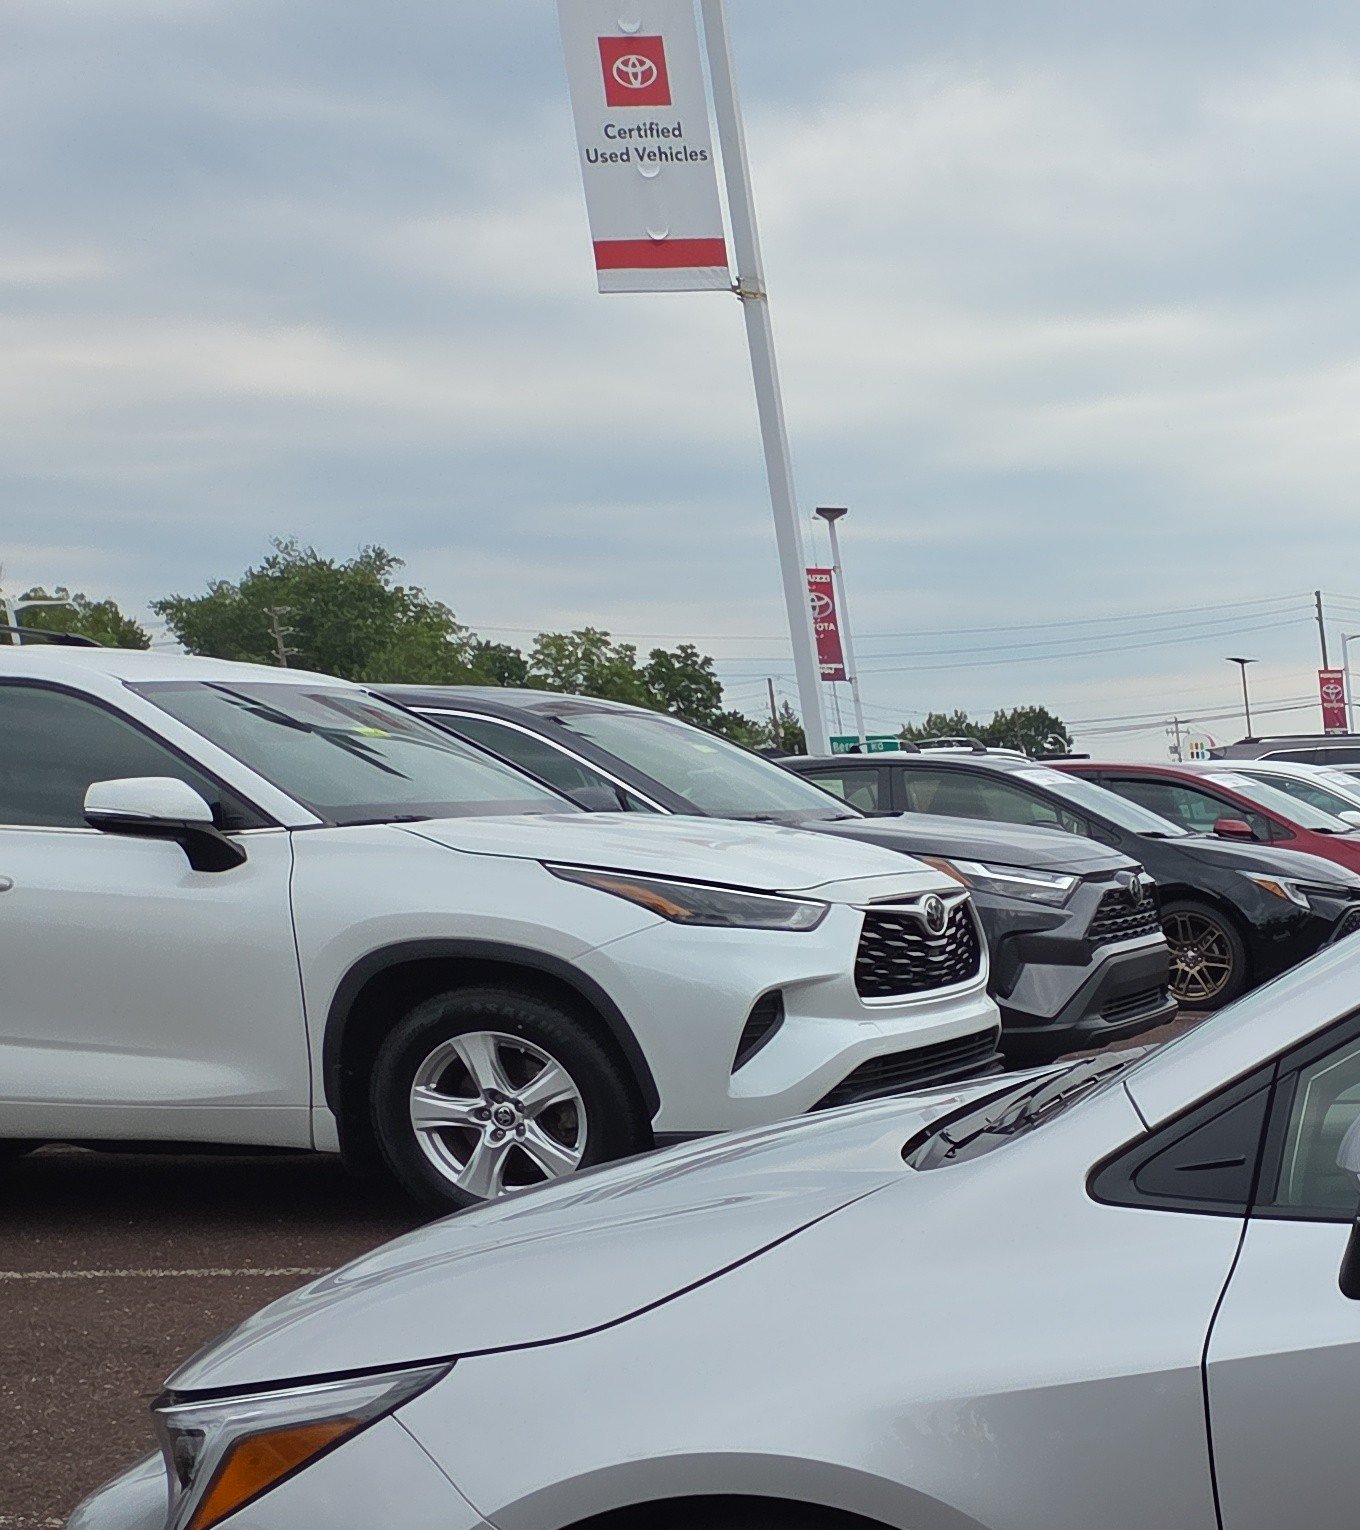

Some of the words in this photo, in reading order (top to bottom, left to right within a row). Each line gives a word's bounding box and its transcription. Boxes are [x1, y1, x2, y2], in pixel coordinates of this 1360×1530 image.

[604, 122, 683, 140] Certified
[586, 147, 631, 164] Used
[634, 146, 708, 163] Vehicles
